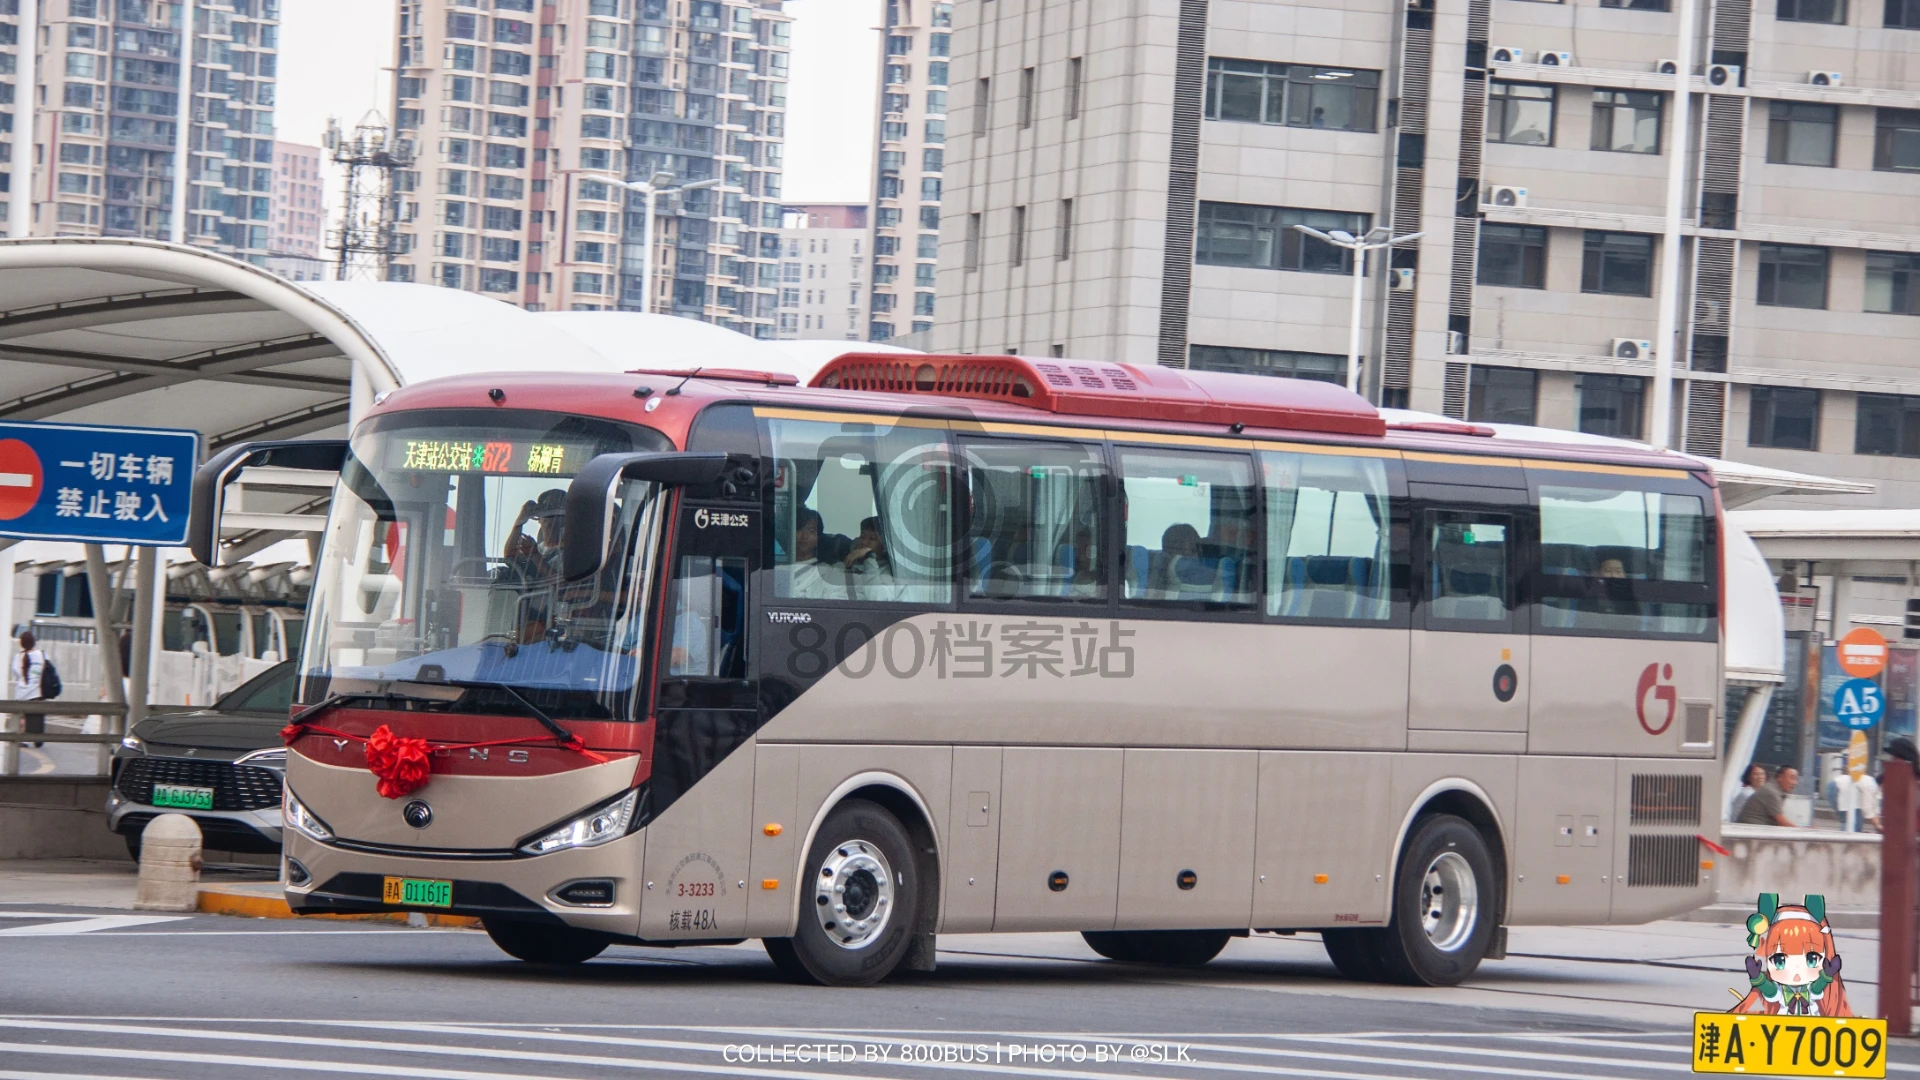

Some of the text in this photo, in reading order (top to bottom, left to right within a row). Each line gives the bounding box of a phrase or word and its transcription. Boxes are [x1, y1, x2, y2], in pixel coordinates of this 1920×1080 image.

[60, 452, 174, 486] 一切车辆
[403, 442, 564, 473] 天津站公交站 672 杨柳青
[55, 487, 169, 523] 禁止驶入
[711, 513, 748, 527] 天津公交
[768, 612, 811, 623] YUTONG
[1837, 687, 1879, 715] A5
[678, 883, 714, 896] 3-3233
[669, 909, 718, 931] 核载48人
